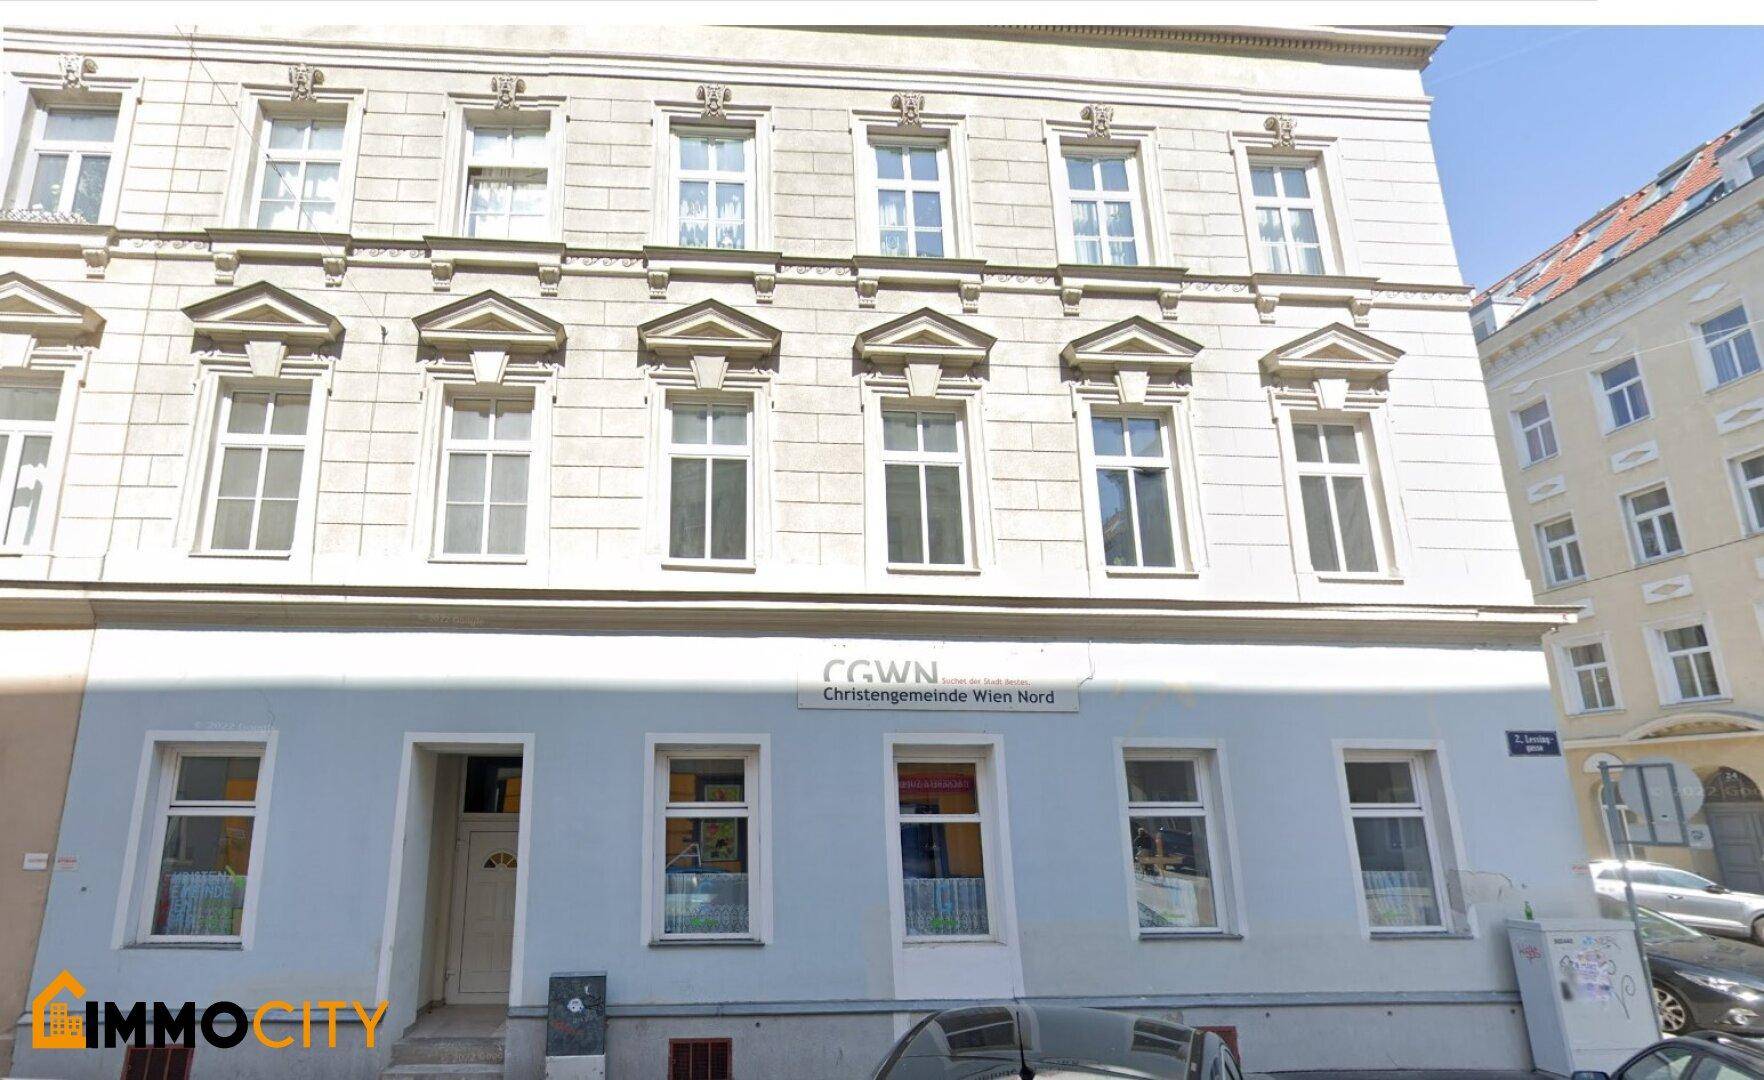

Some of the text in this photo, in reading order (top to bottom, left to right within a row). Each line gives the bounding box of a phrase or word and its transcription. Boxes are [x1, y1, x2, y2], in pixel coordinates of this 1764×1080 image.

[823, 659, 938, 683] CGWN
[941, 677, 1031, 687] Suchet der Stadt Bestes.
[823, 687, 1055, 703] Christengemeinde Wien Nord
[1513, 734, 1524, 744] 2.
